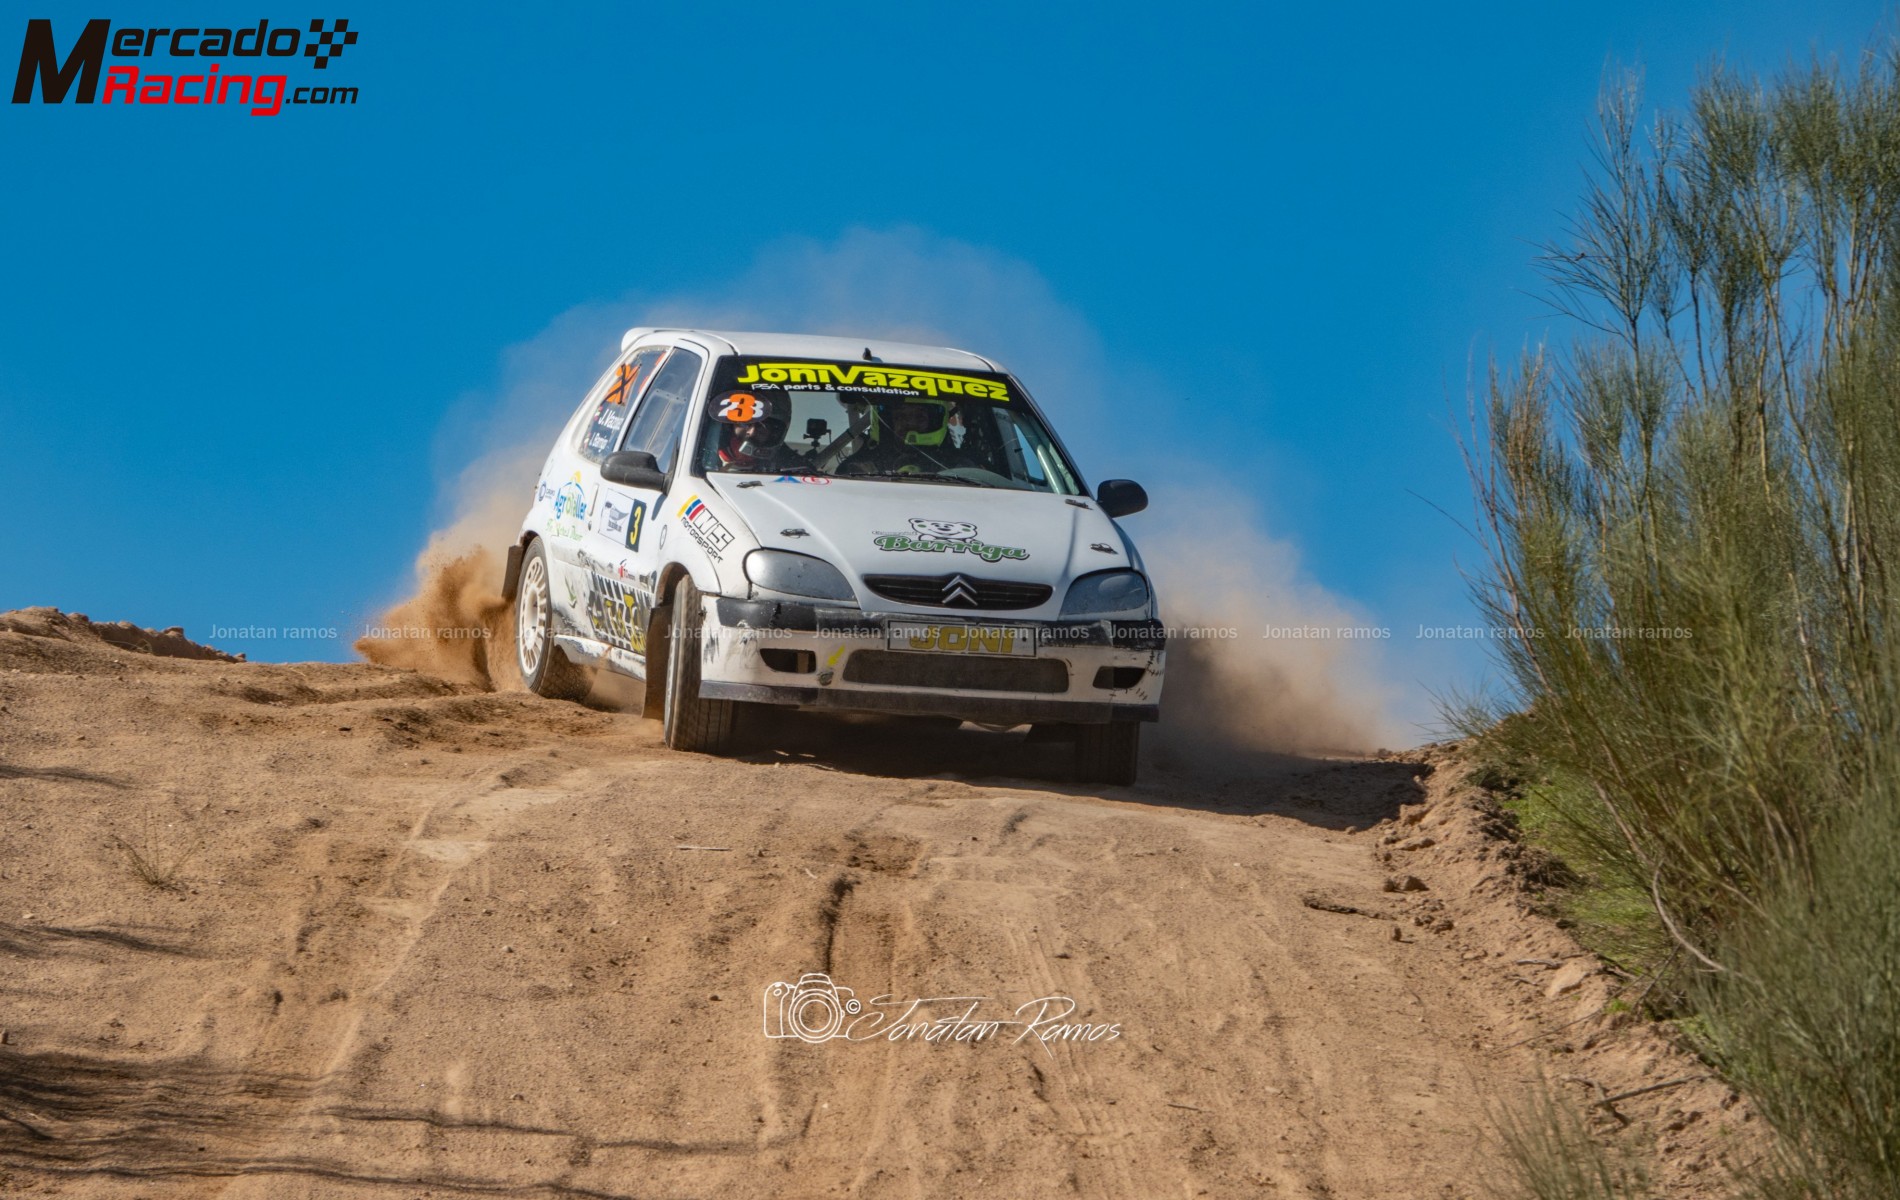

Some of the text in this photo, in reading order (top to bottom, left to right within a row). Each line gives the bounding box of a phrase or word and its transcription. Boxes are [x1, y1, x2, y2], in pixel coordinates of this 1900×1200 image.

[836, 386, 920, 396] consultation
[630, 506, 642, 545] 3
[873, 535, 1030, 562] Barriga
[909, 625, 1013, 653] JONI
